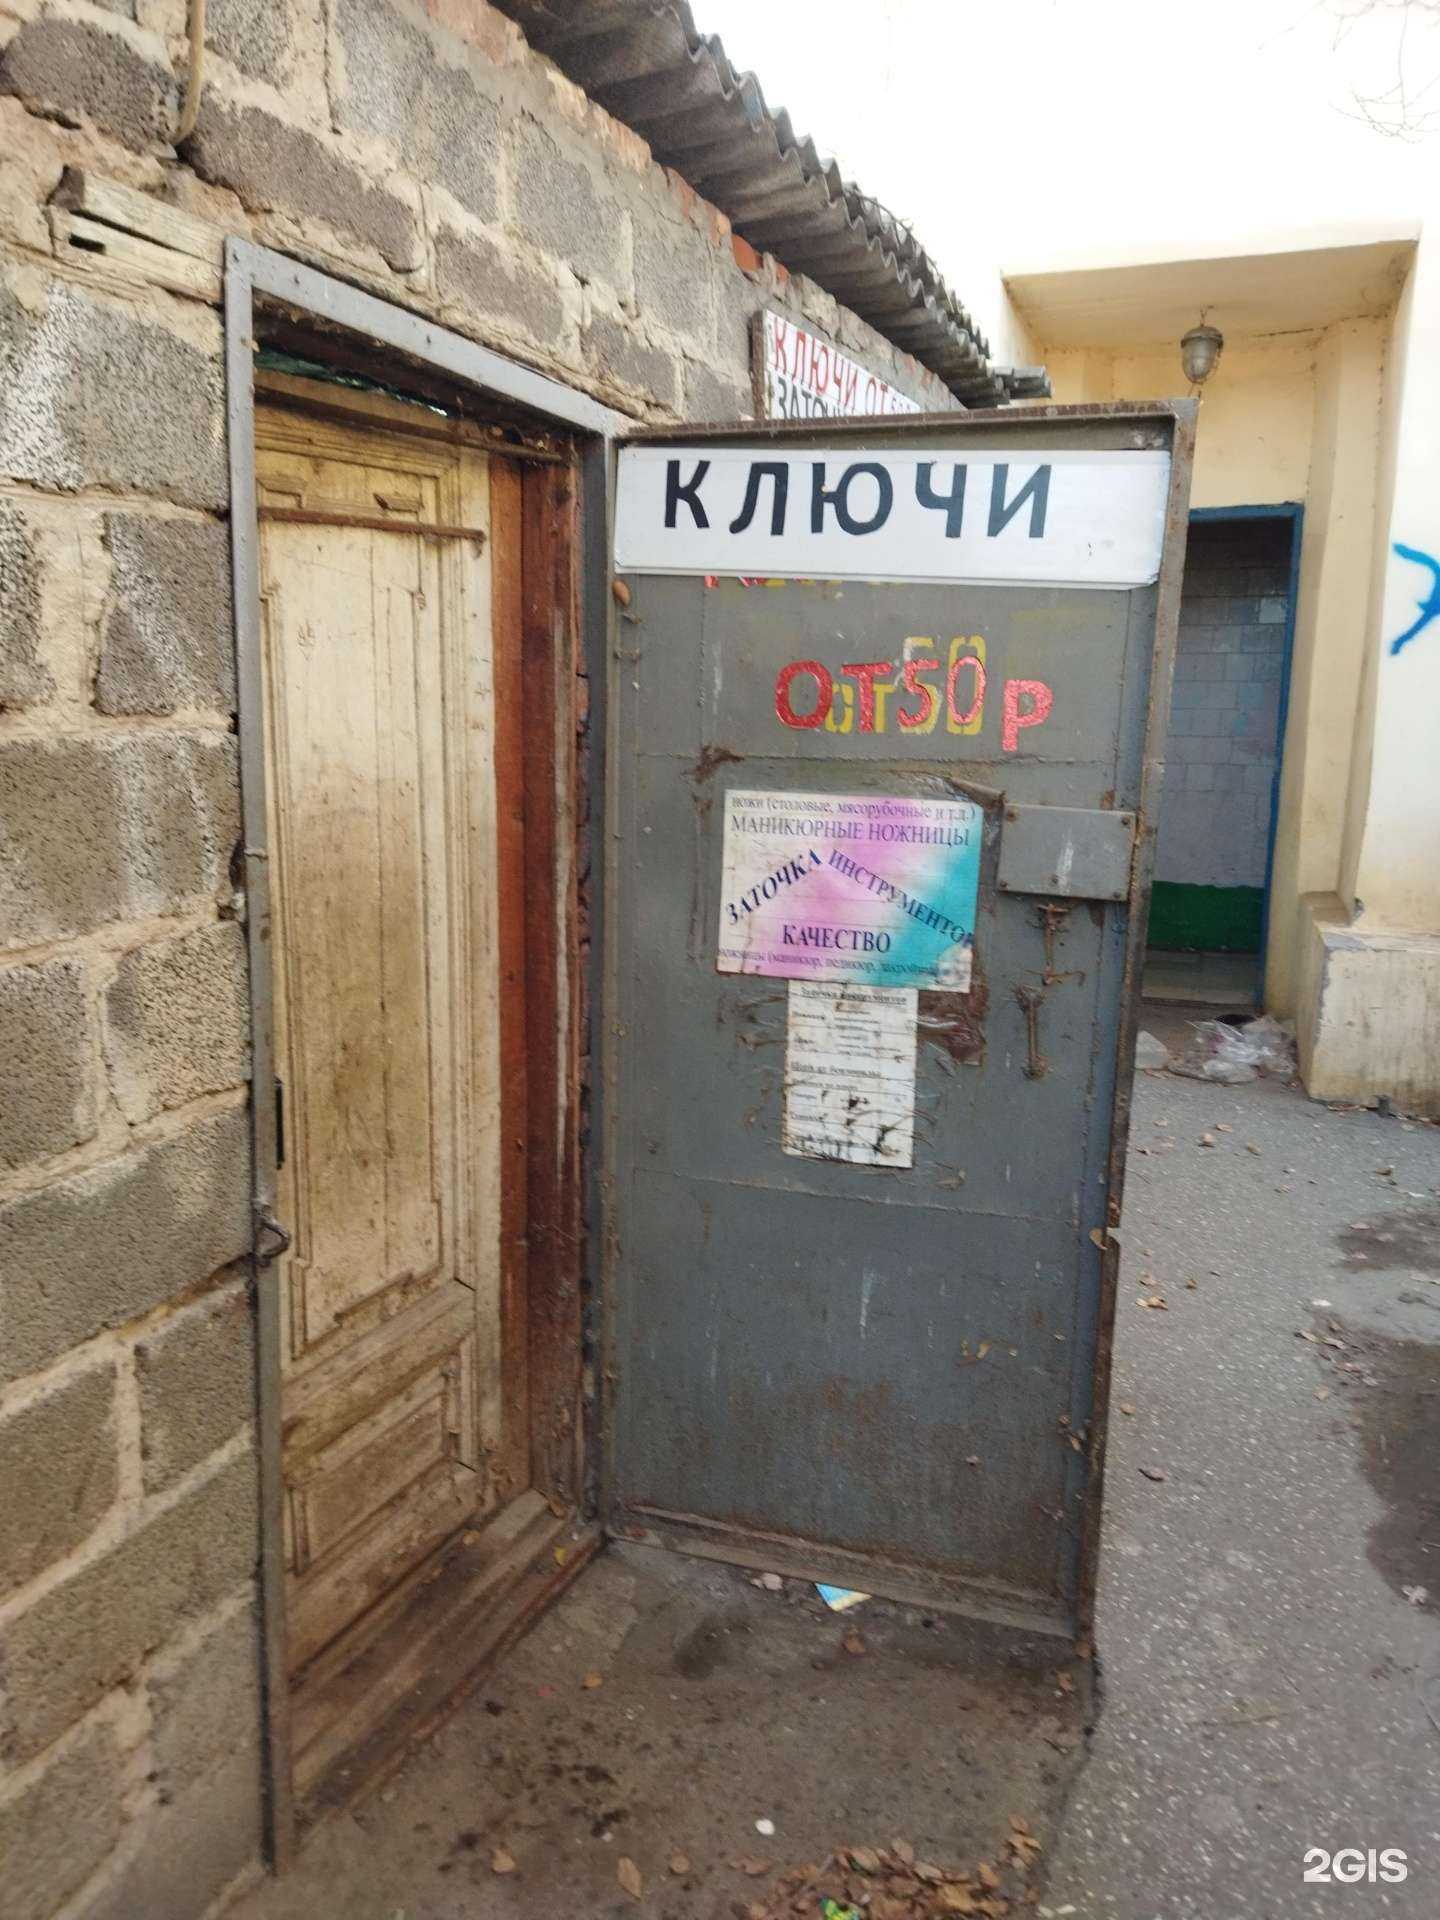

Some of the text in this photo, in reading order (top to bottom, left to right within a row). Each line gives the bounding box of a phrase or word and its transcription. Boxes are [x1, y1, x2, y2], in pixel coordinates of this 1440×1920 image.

[774, 316, 889, 415] КЛЮЧИ ОТ
[664, 459, 1052, 539] КЛЮЧИ
[730, 815, 970, 847] МАНИКЮРНЫЕ НОЖНИЦЫ
[725, 849, 824, 926] ЗАТОЧКА
[782, 924, 892, 954] КАЧЕСТВО
